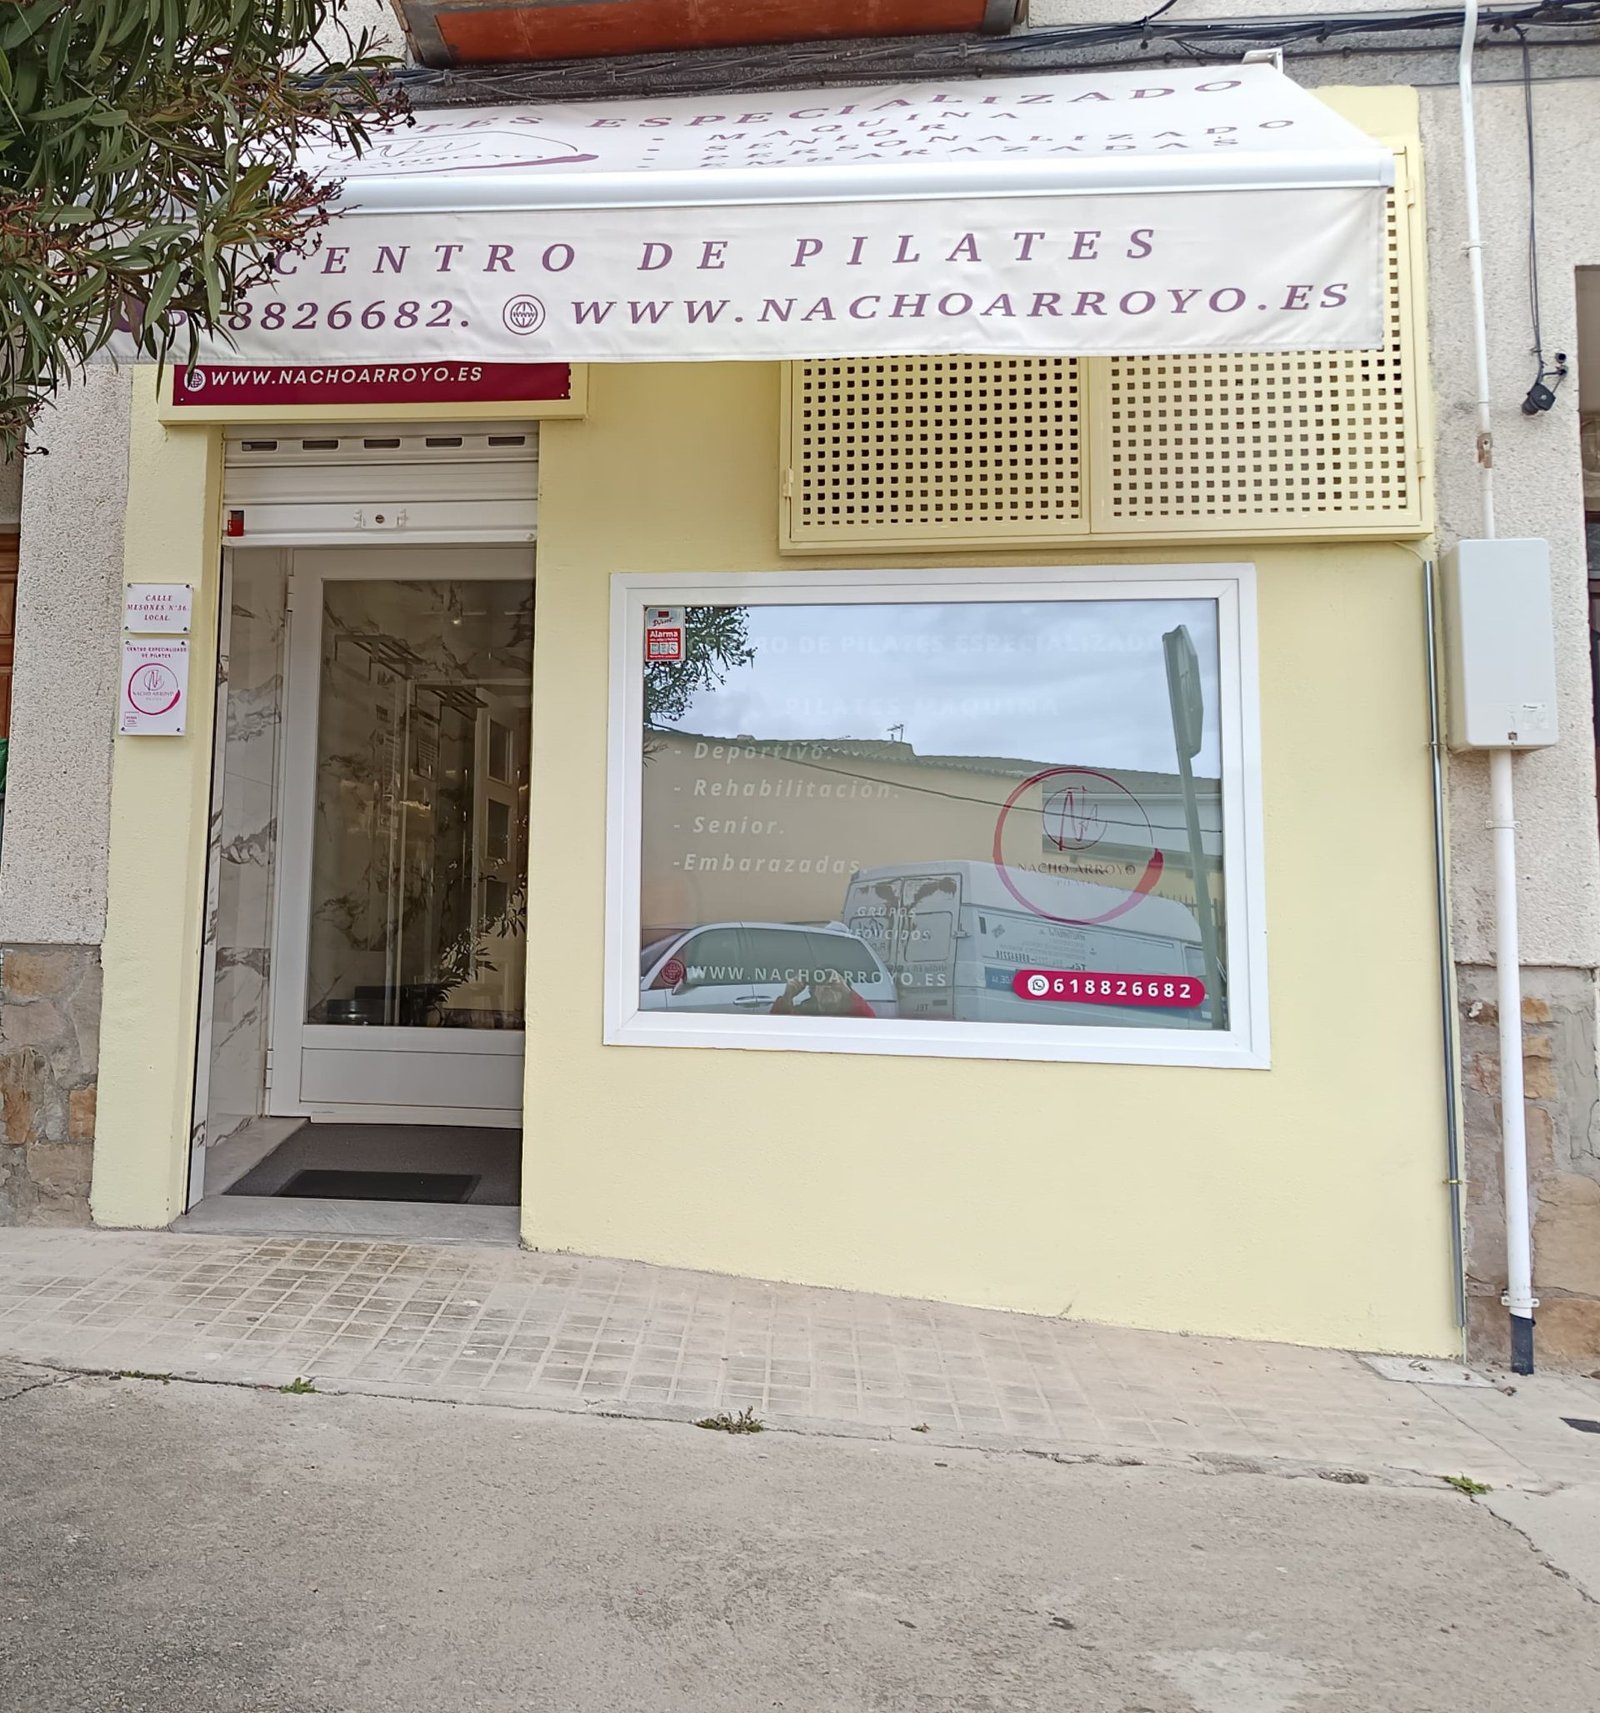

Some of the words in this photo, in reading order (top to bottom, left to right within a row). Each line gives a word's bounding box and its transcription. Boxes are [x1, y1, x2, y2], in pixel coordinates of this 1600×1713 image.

[585, 80, 1242, 128] ESPECIALIZADO
[707, 111, 1018, 141] MAQUINA
[274, 242, 575, 275] CENTRO
[637, 240, 728, 270] DE
[791, 229, 1156, 267] PILATES
[570, 283, 1349, 325] WWW.NACHOARROYO.ES
[211, 366, 483, 386] WWW.NACHOARROYO.ES
[693, 779, 900, 799] Rehabilitación.
[692, 816, 785, 834] Senior.
[1018, 862, 1070, 875] NACHO
[857, 906, 916, 918] GRUPOS
[691, 966, 945, 987] WWW.NACHOARROYO.ES
[1053, 977, 1191, 999] 618826682
